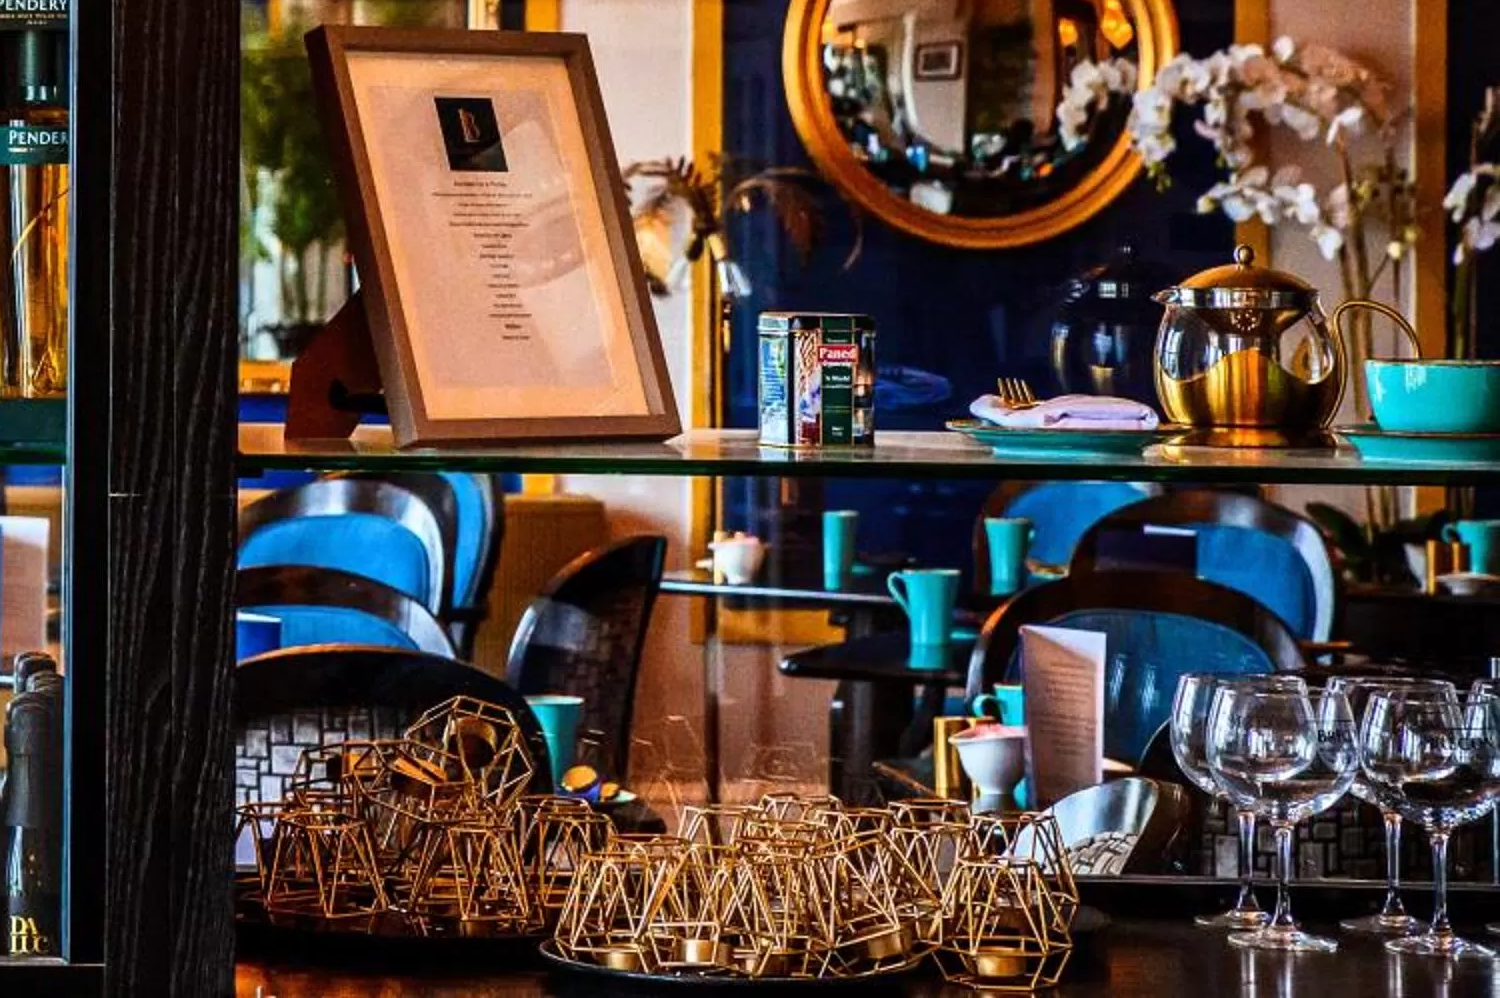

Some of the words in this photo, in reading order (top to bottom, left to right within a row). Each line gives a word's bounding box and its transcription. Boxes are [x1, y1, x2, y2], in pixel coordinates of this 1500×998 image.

[9, 129, 68, 145] PENDER
[10, 916, 38, 935] DA
[10, 935, 49, 953] LUC
